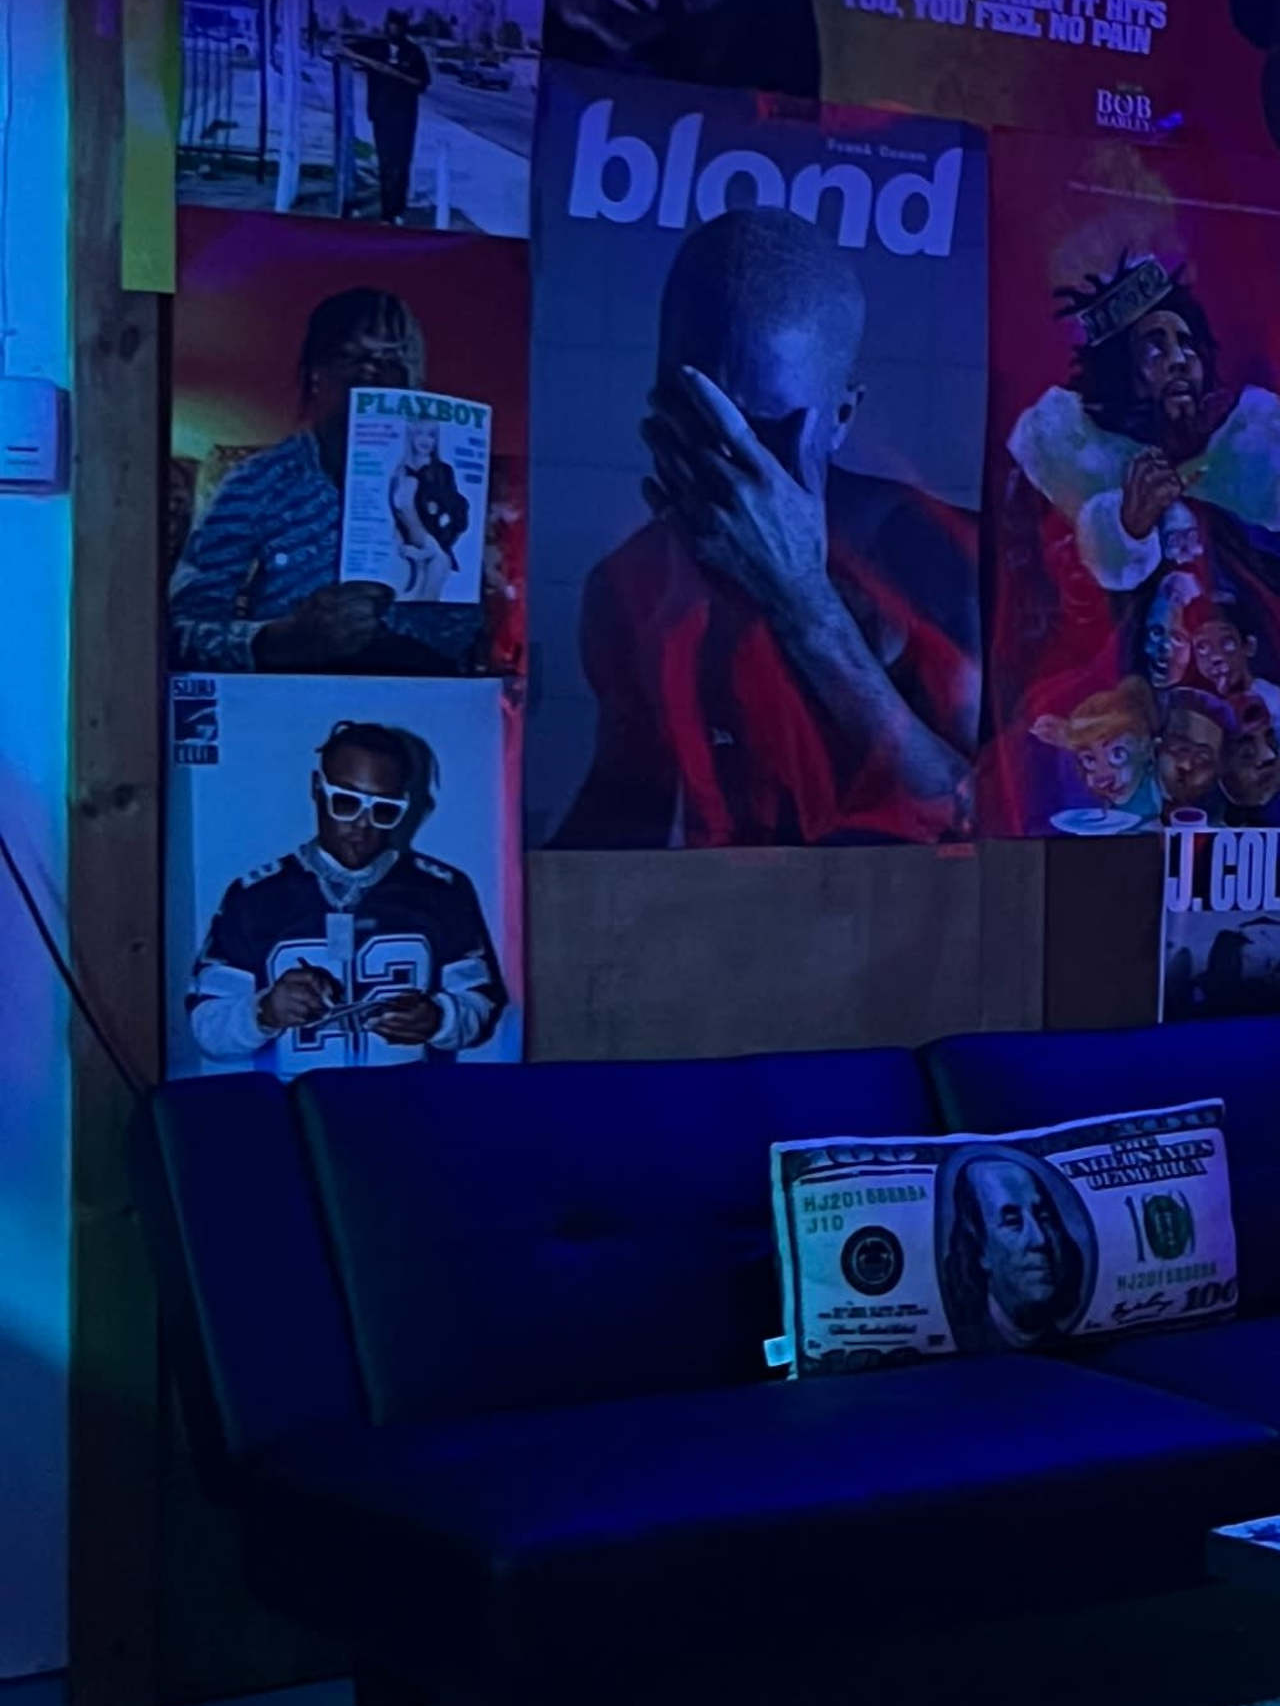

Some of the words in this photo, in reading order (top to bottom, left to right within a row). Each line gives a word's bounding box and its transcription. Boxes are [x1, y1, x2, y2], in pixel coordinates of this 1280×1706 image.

[974, 0, 1043, 37] FEEL
[1049, 11, 1085, 44] NO
[1092, 19, 1151, 55] PAIN
[1096, 88, 1152, 120] BOB
[568, 98, 963, 258] blond
[356, 392, 487, 429] PLAYBOY
[1166, 828, 1203, 913] J.
[1113, 1157, 1209, 1187] AMERICA
[806, 1214, 845, 1234] J10
